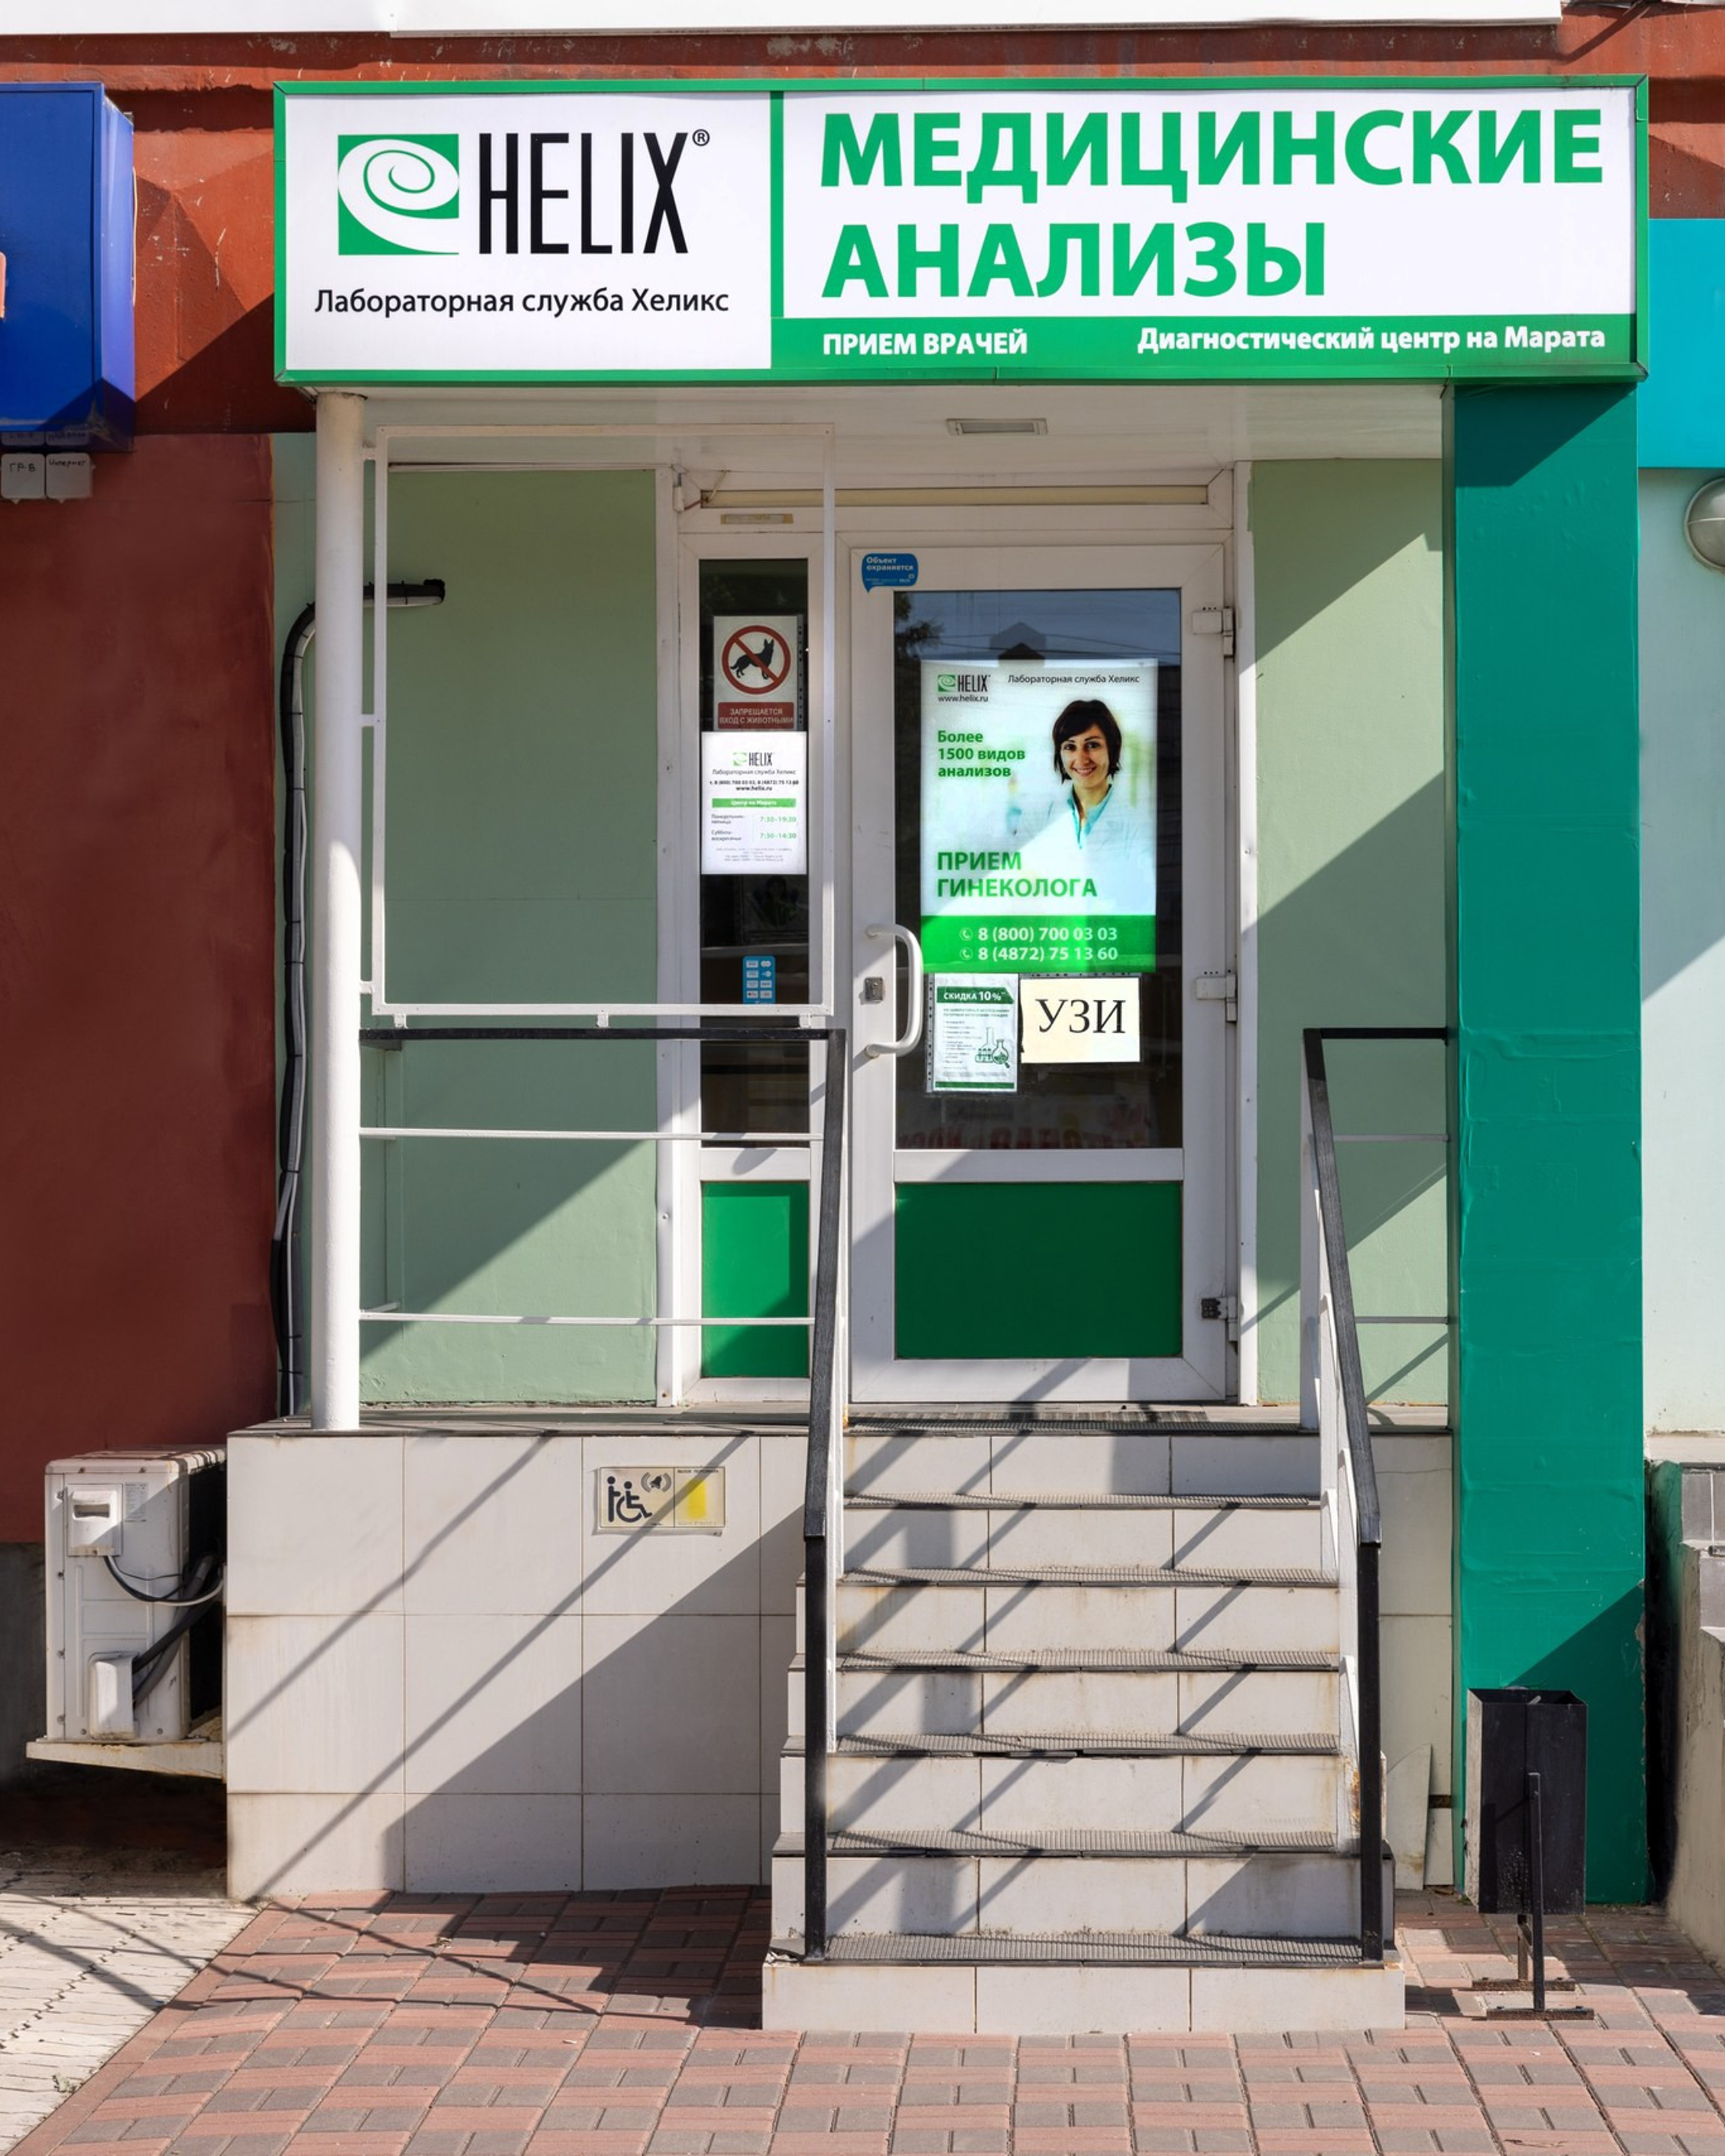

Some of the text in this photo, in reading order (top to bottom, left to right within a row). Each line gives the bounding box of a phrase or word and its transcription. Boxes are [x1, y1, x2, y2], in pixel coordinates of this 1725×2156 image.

[821, 108, 1603, 204] МЕДИЦИНСКИЕ
[821, 221, 1325, 298] АНАЛИЗЫ
[314, 286, 729, 319] Лабораторная служба Хеликс
[823, 328, 1028, 355] ПРИЕМ ВРАЧЕЙ
[1137, 325, 1606, 354] Диагностический центр на Марата
[958, 674, 989, 693] HELIX
[1007, 674, 1140, 684] Лабораторная служба Хеликс
[937, 694, 989, 702] www.helix.ru
[730, 707, 783, 716] ЗАПРЕЩАЕТСЯ
[720, 717, 739, 725] ВХОД
[937, 730, 984, 743] Более
[749, 752, 773, 766] HELIX
[938, 747, 1026, 762] 1500 видов
[938, 767, 1011, 778] анализов
[937, 852, 1022, 870] ПРИЕМ
[937, 879, 1098, 897] ГИНЕКОЛОГА
[978, 926, 1117, 943] 8 (800) 700 03 03
[978, 947, 1119, 962] 8 (4872) 75 13 60
[943, 992, 977, 1001] СКИДКА
[1035, 998, 1126, 1034] УЗИ
